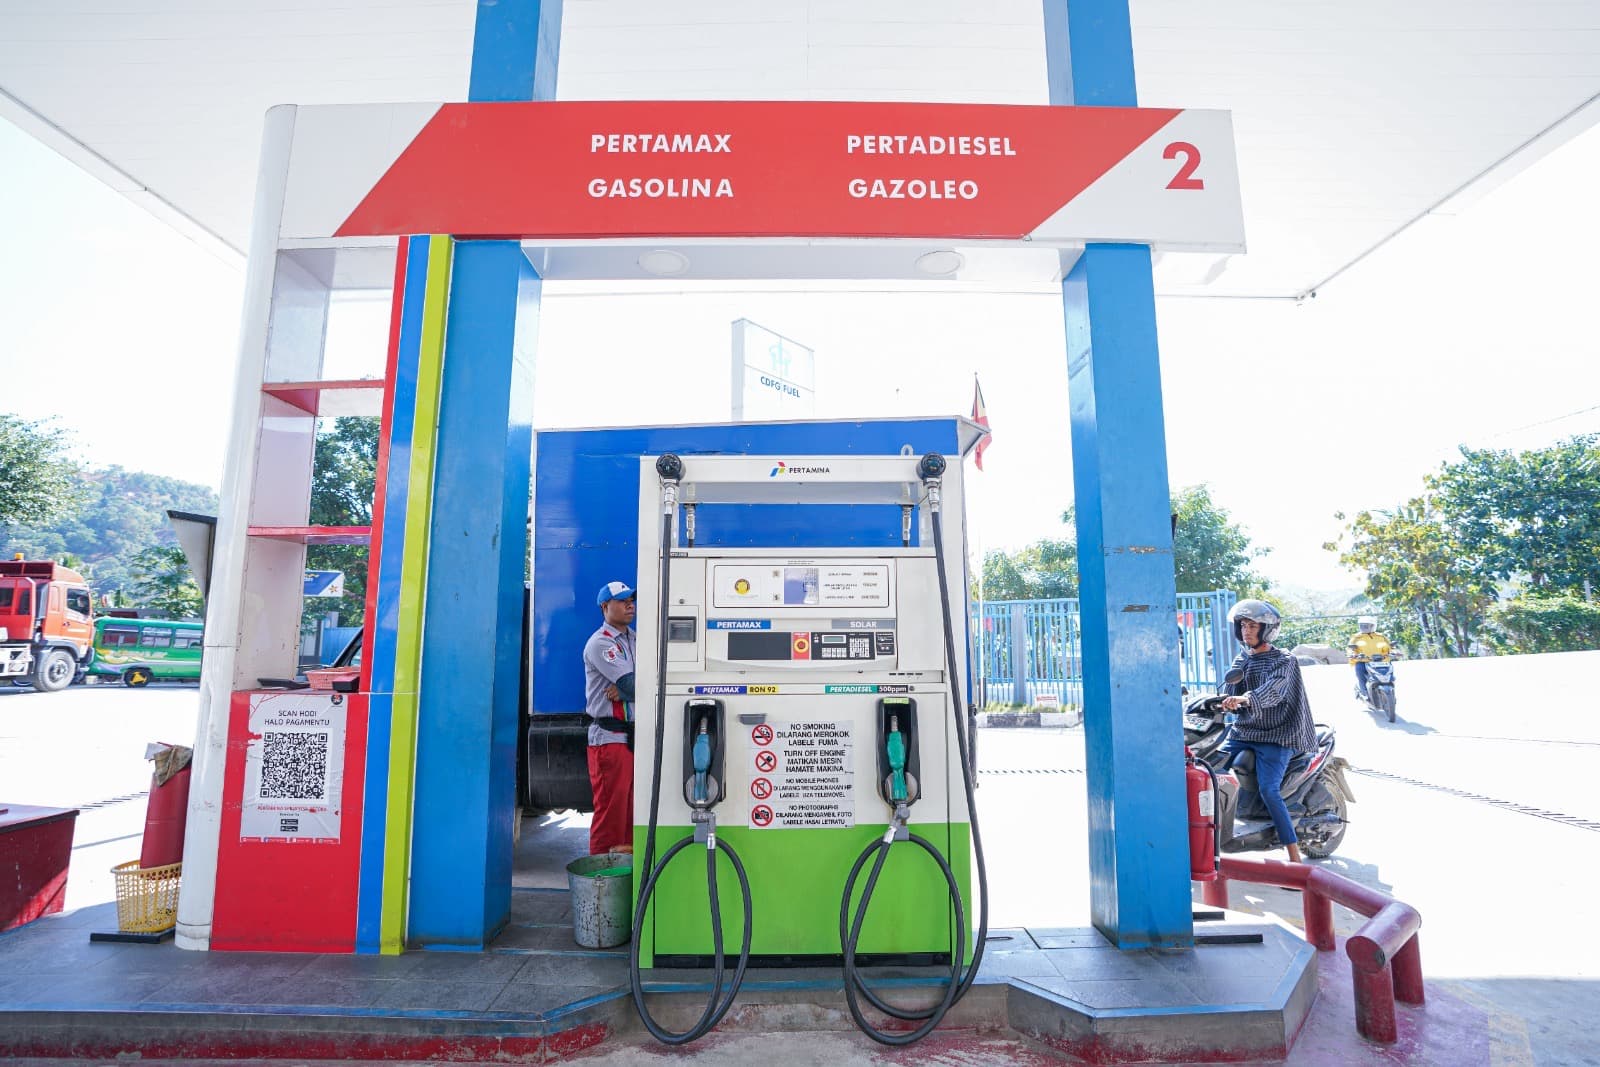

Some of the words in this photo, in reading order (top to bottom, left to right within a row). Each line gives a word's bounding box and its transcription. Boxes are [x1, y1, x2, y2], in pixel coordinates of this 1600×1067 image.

[590, 134, 732, 153] PERTAMAX
[847, 135, 1017, 156] PERTADIESEL
[1162, 141, 1204, 189] 2
[587, 178, 734, 198] GASOLINA
[848, 178, 979, 200] GAZOLEO
[760, 376, 781, 391] CDFG
[783, 384, 801, 398] FUEL
[716, 621, 761, 629] PERTAMAX
[879, 685, 907, 693] 500ppm
